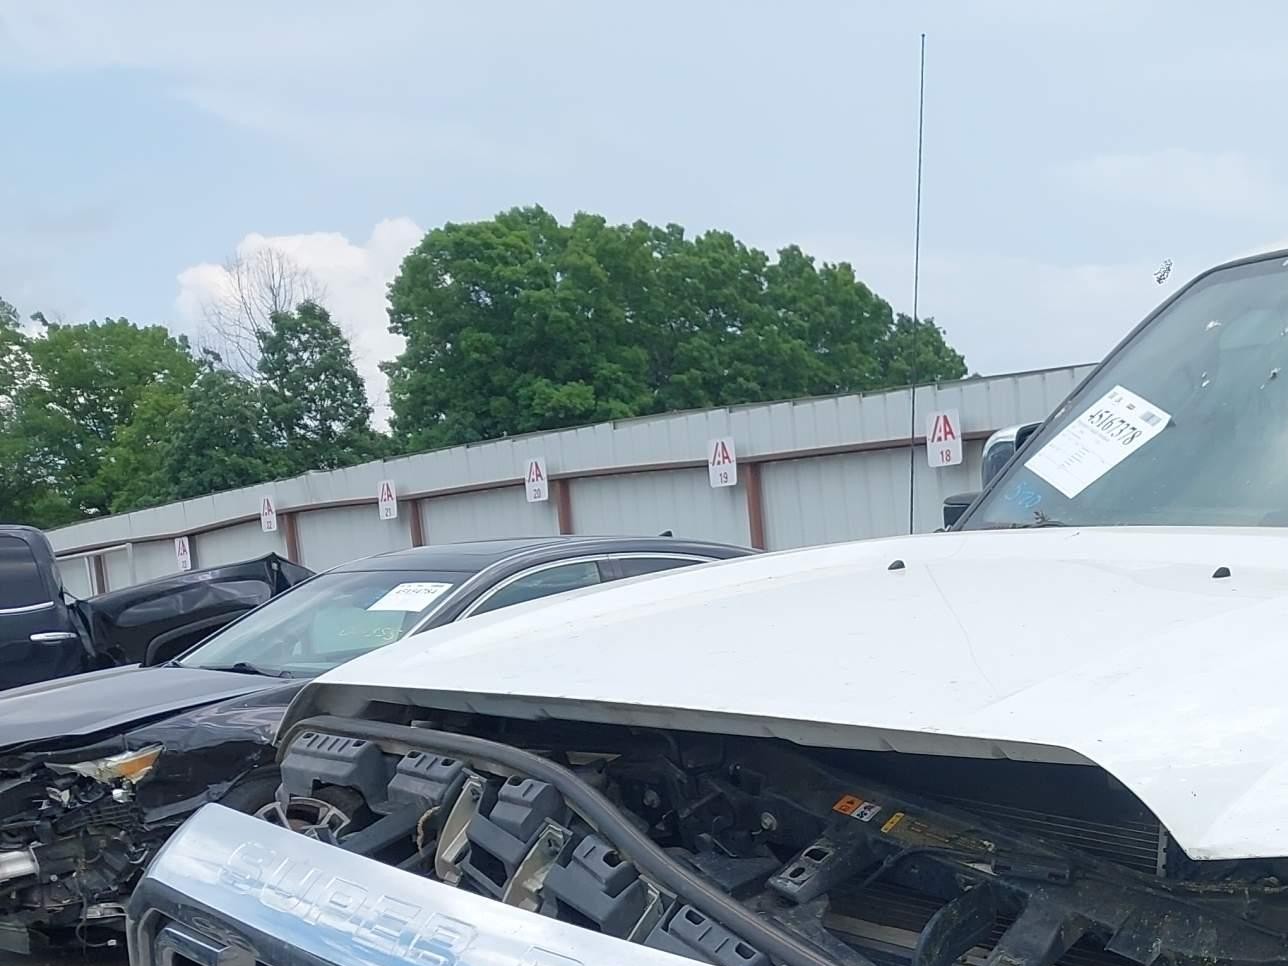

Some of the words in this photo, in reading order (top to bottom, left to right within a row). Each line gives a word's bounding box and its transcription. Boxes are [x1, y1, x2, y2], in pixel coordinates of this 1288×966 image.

[1087, 409, 1143, 446] 45167378
[940, 449, 951, 464] 18
[719, 471, 729, 484] 19
